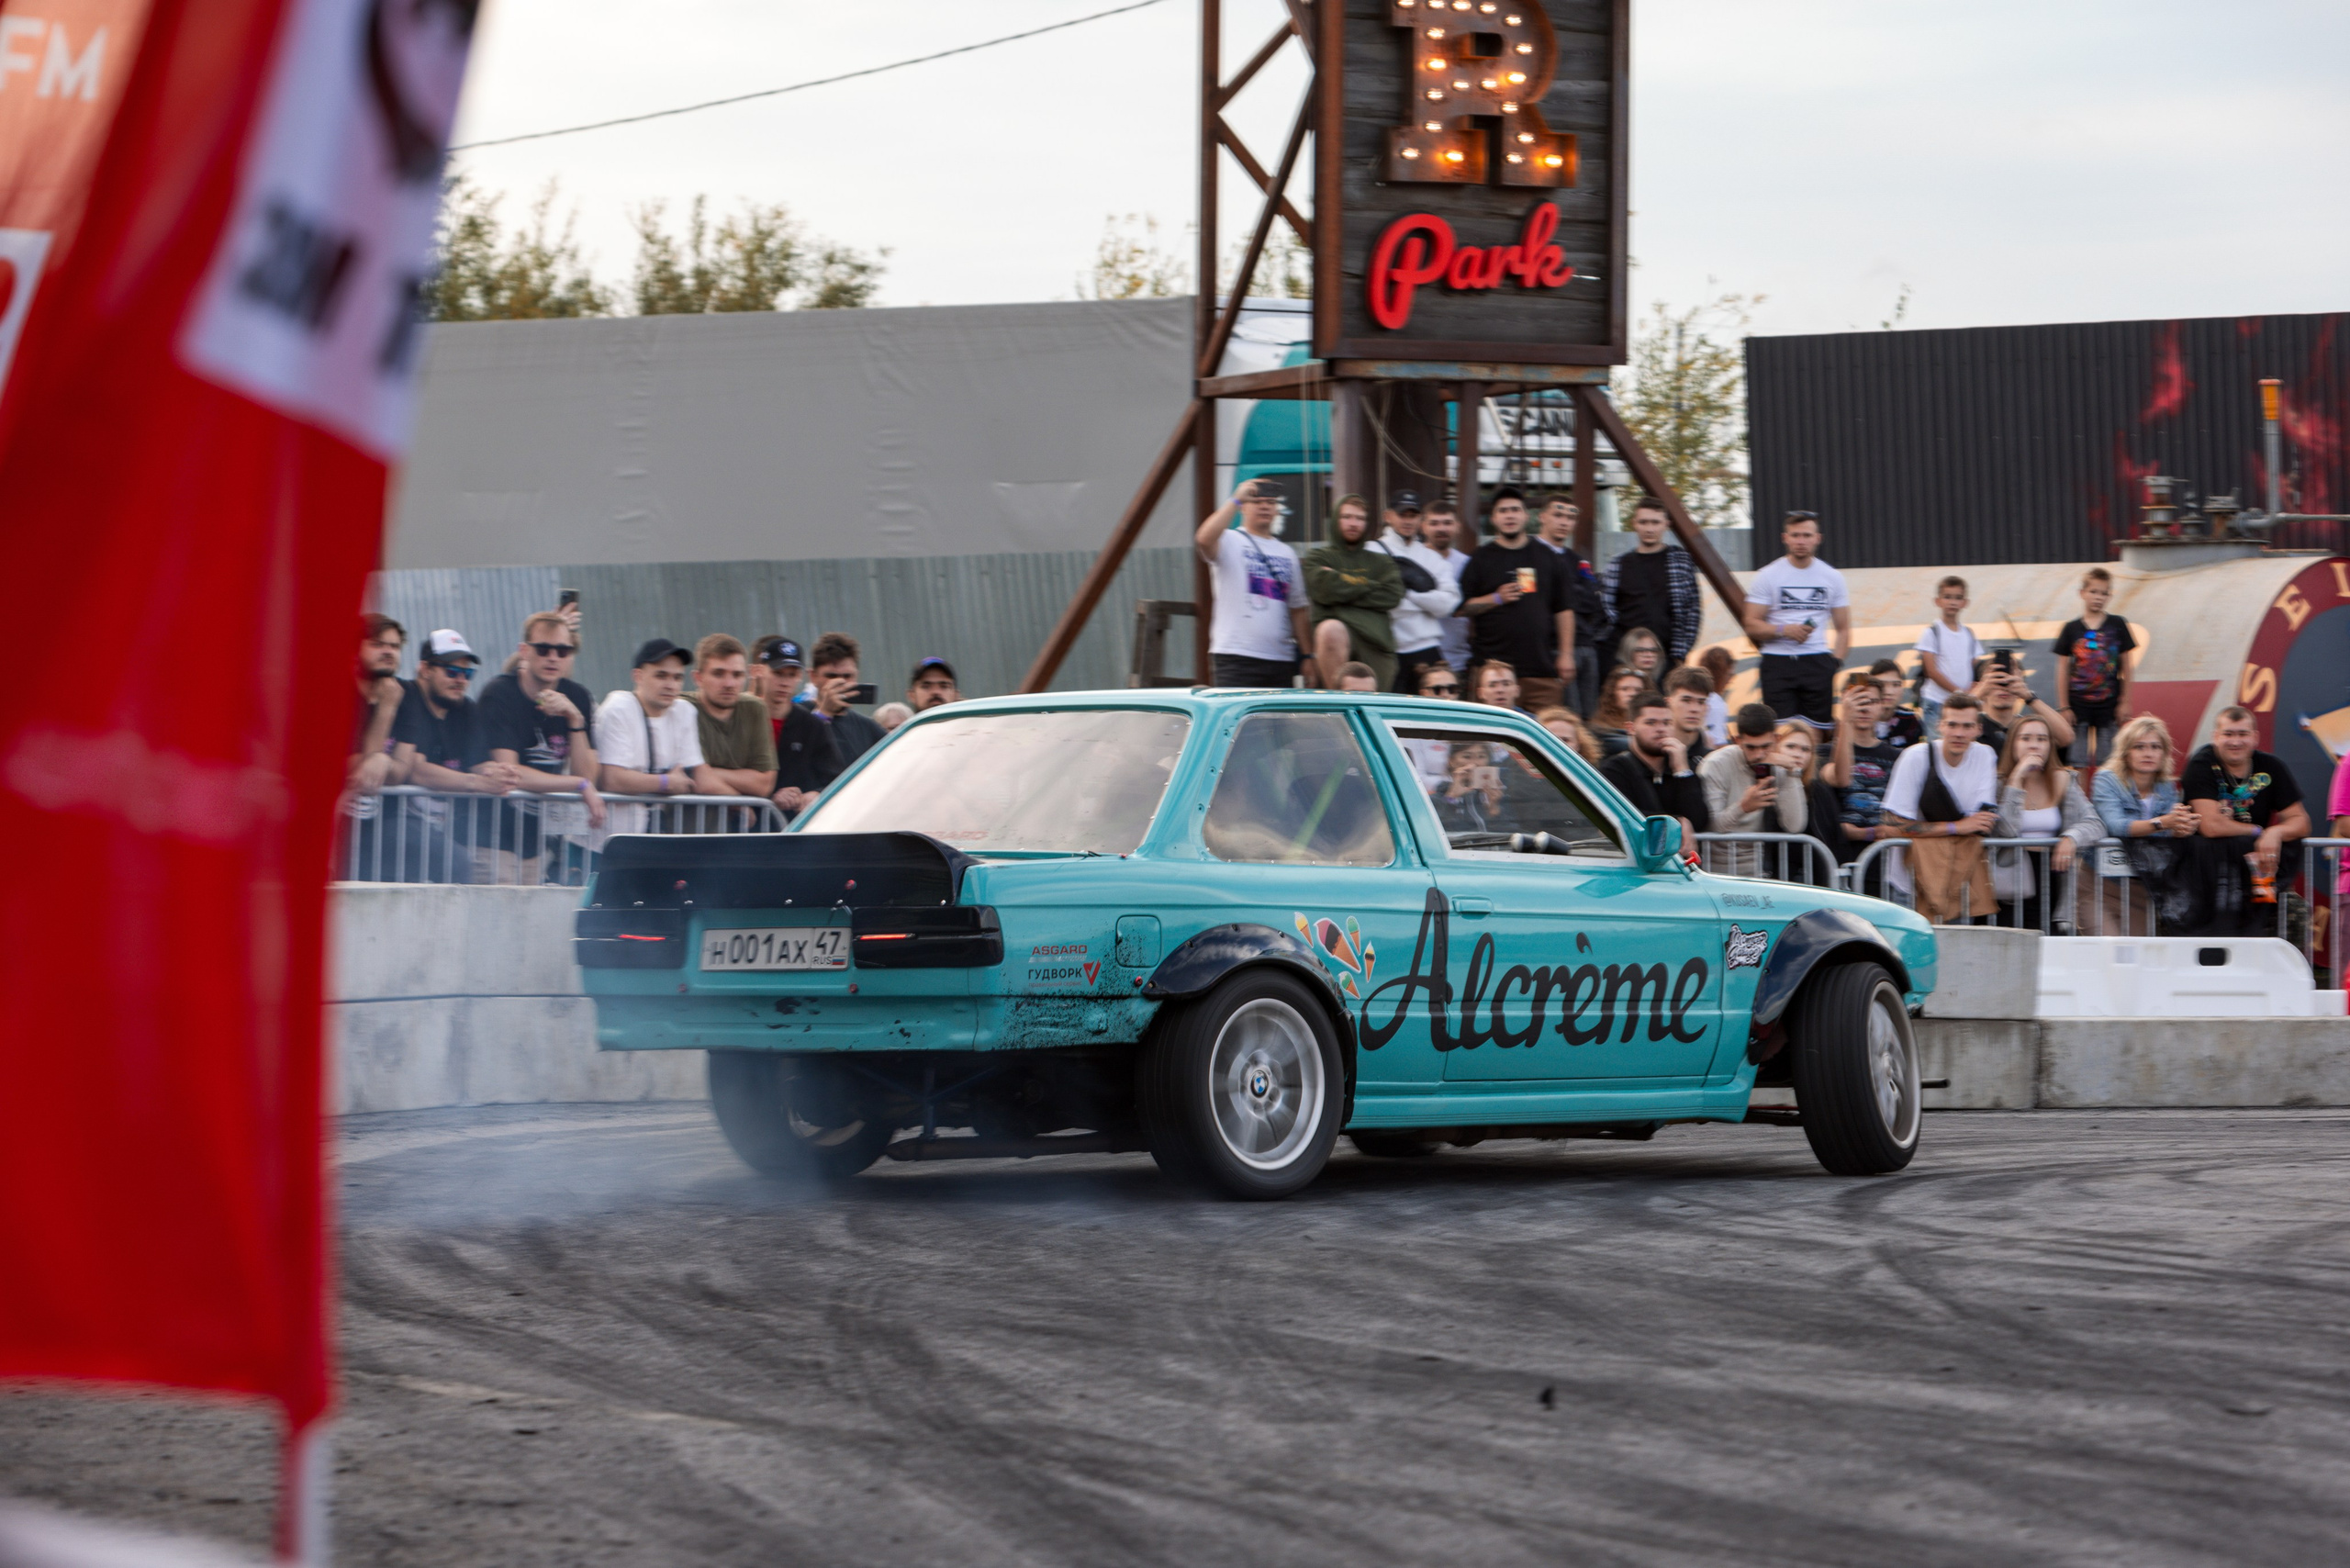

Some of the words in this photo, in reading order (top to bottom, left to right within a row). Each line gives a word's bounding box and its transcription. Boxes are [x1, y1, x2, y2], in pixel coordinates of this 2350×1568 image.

[1389, 0, 1577, 187] R
[1366, 201, 1575, 330] Park
[816, 930, 842, 956] 47
[1031, 945, 1088, 956] ASGARD
[812, 956, 833, 965] RUS
[1028, 967, 1082, 981] ГУДВОРК
